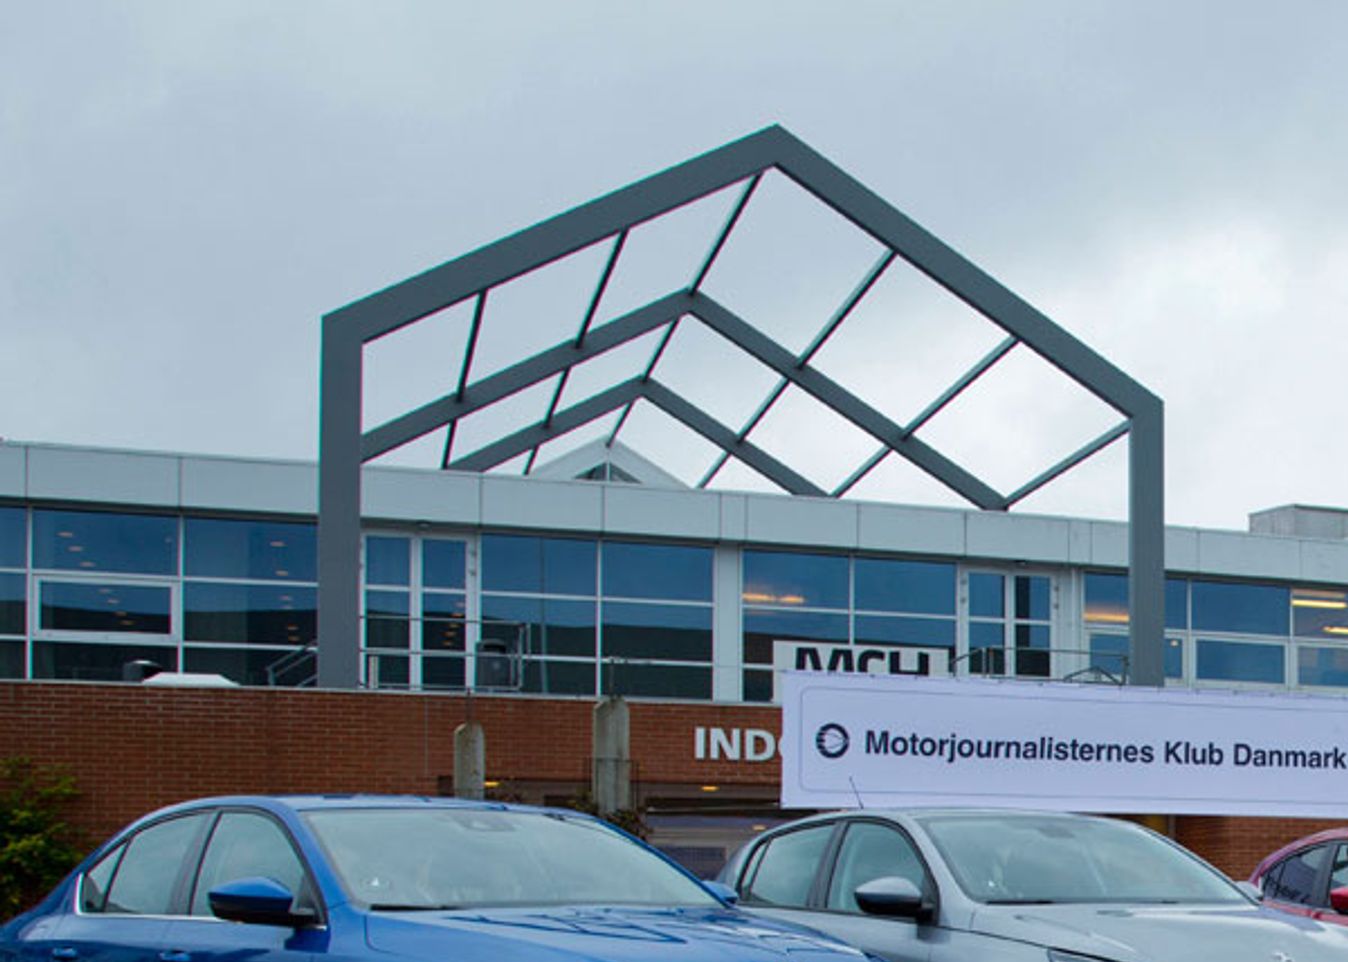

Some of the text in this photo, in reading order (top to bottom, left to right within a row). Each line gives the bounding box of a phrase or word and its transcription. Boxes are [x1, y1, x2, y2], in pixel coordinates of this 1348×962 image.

[694, 726, 783, 762] IND
[865, 730, 1348, 770] Motorjournalisternes Klub Danmark
